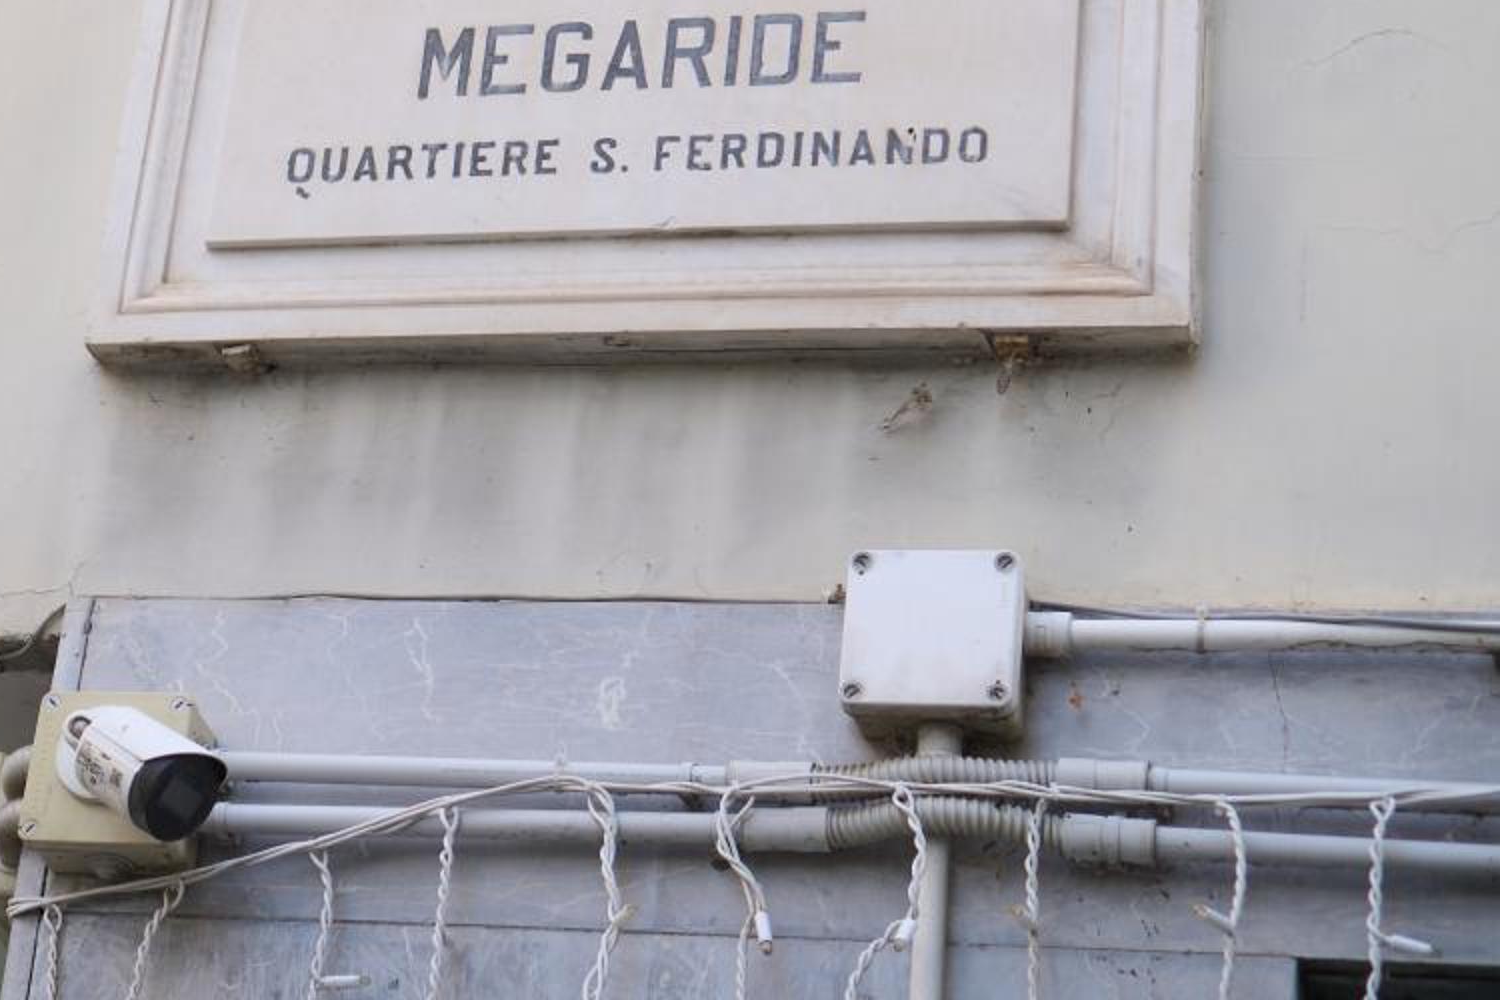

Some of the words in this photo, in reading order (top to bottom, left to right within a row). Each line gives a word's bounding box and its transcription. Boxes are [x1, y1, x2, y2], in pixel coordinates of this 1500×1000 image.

[417, 10, 867, 100] MEGARIDE
[286, 138, 560, 199] QUARTIERE
[590, 137, 629, 174] S.
[653, 126, 989, 172] FERDINANDO
